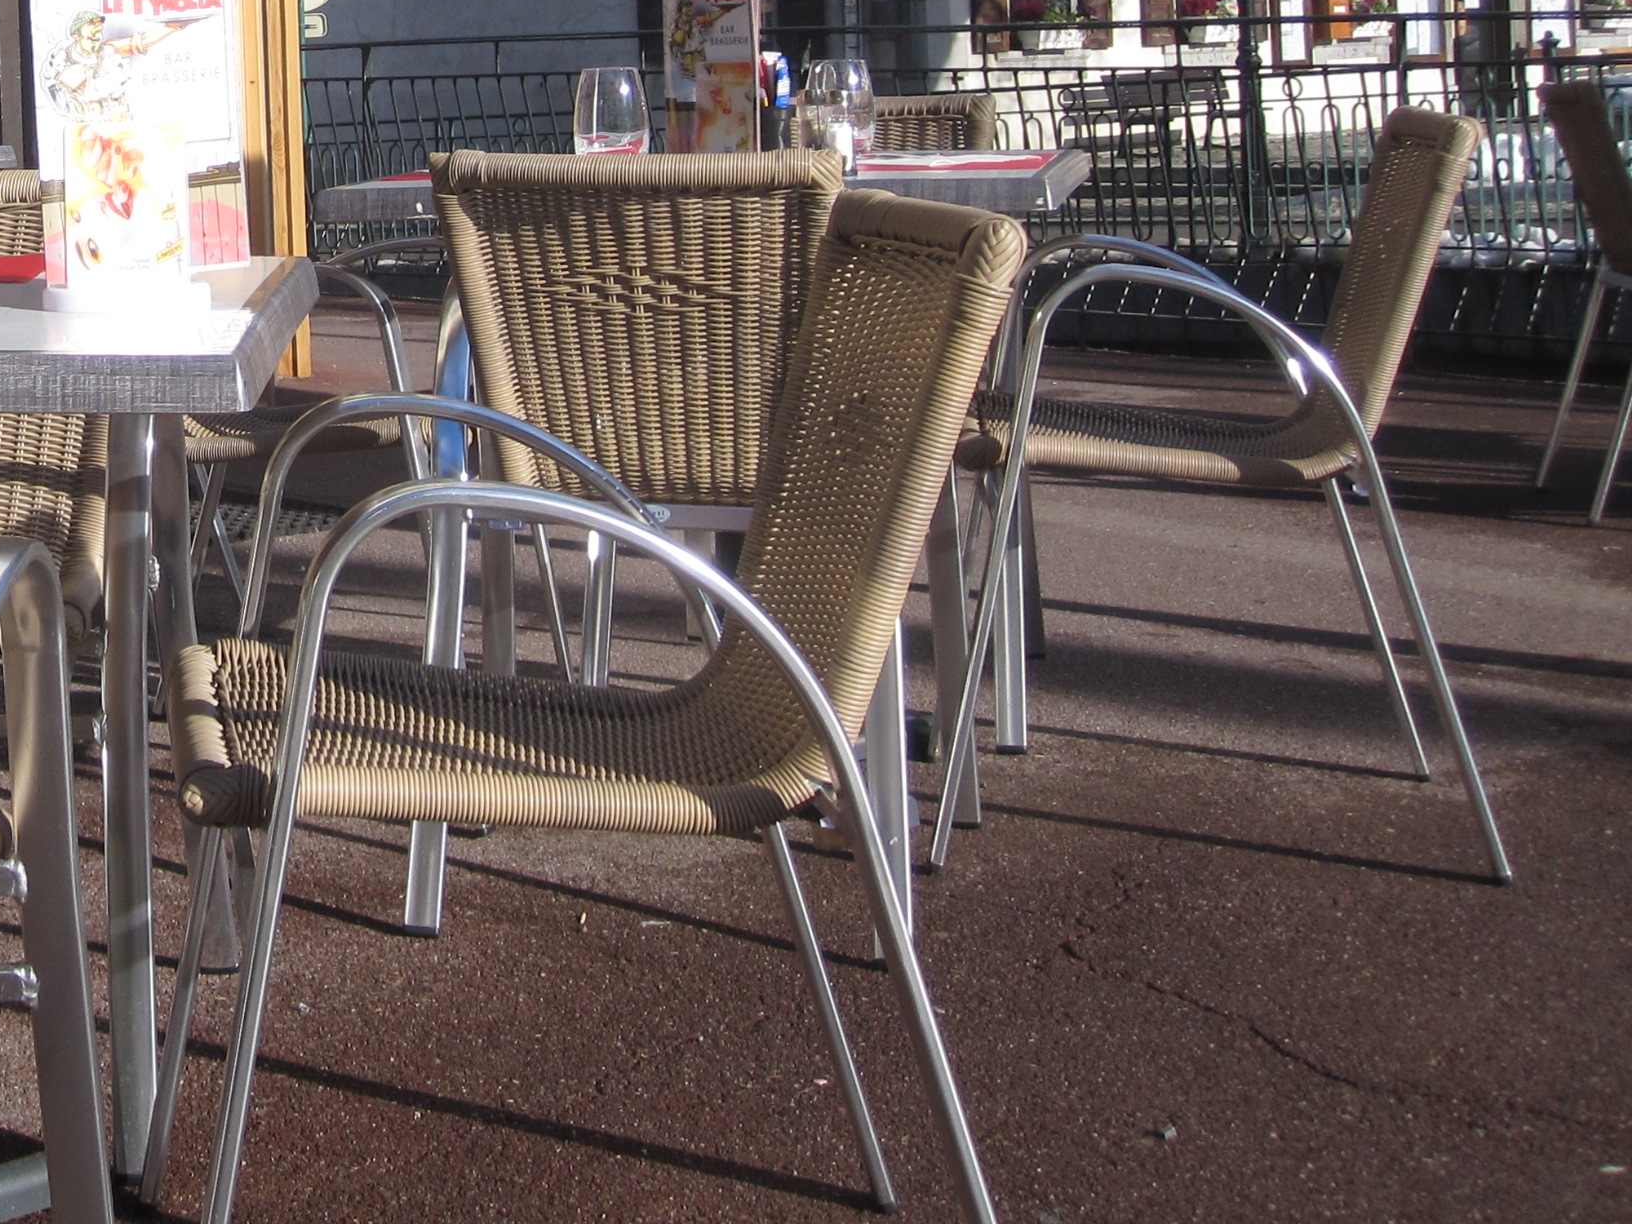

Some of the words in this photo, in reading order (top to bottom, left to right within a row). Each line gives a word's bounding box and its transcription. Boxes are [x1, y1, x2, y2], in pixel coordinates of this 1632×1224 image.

[720, 25, 735, 34] BAR
[710, 36, 749, 46] BRASSERIE
[165, 51, 193, 66] BAR
[142, 67, 221, 86] BRASSERIE
